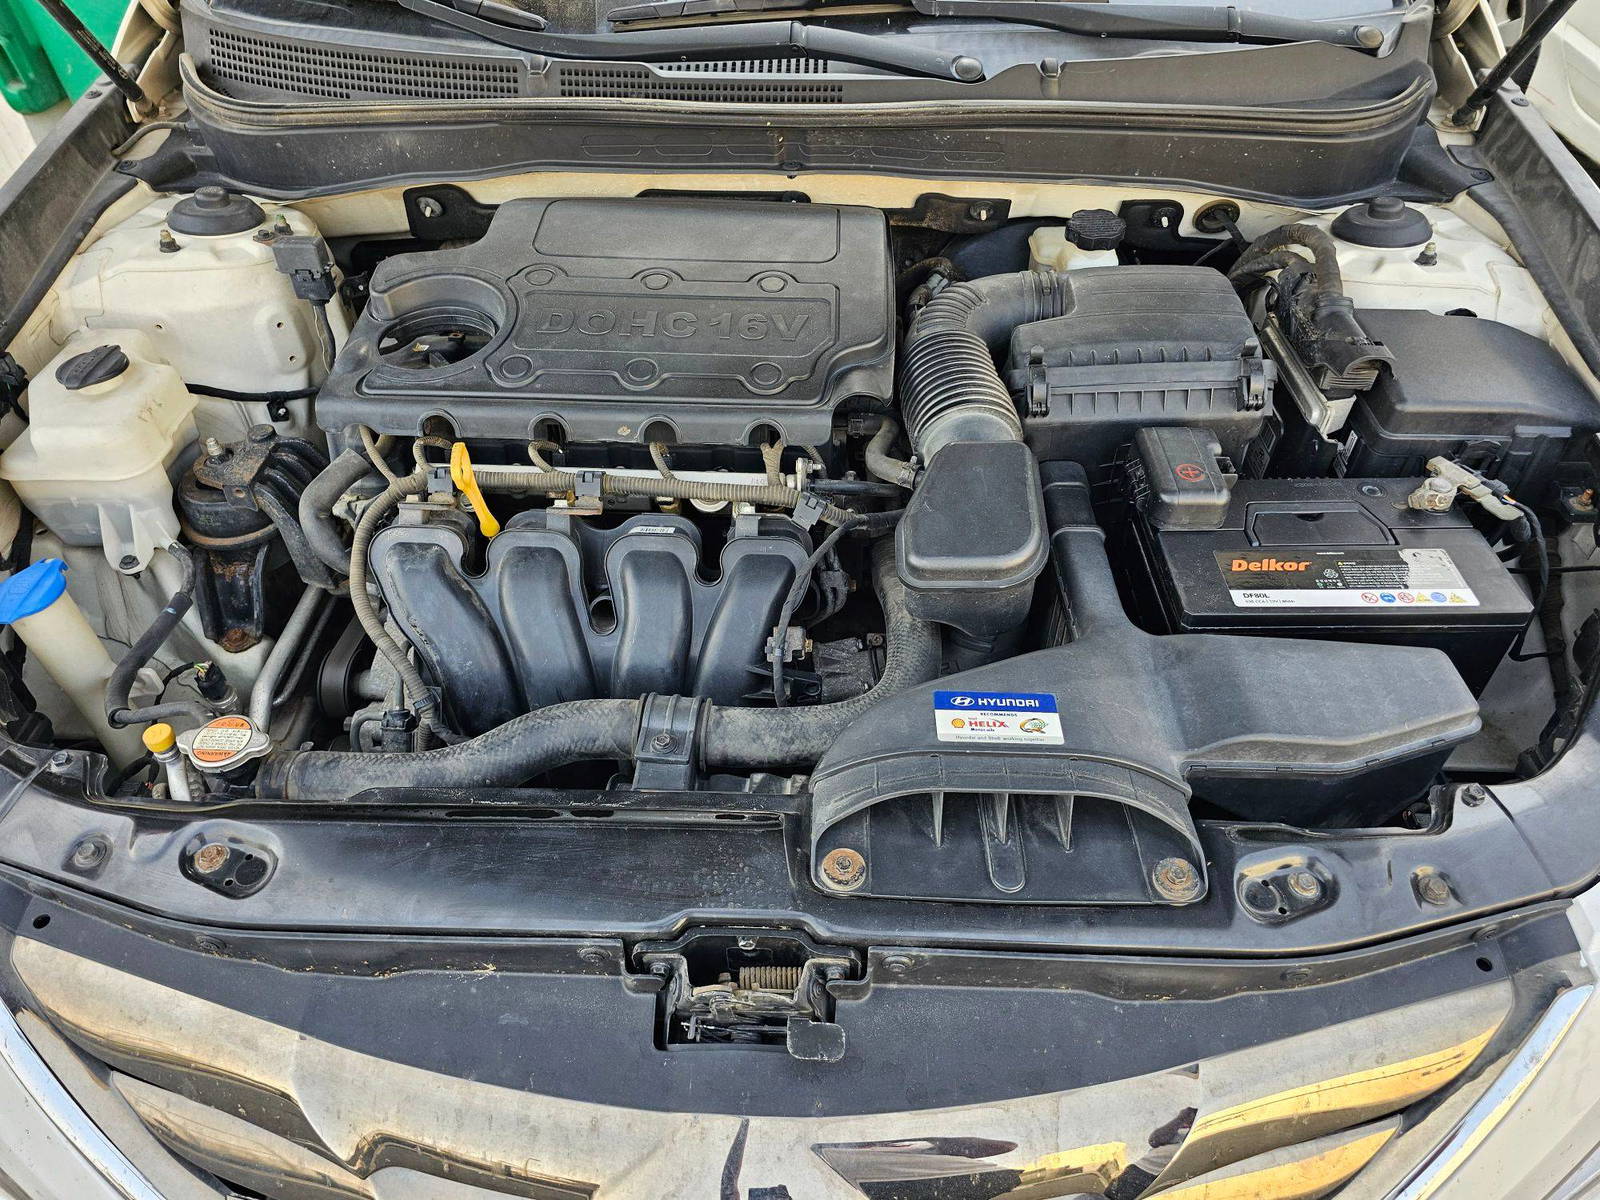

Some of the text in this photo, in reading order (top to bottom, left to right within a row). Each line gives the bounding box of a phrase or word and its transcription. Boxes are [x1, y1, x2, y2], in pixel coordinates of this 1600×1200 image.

[536, 307, 809, 341] DOHC 16V
[1231, 559, 1310, 572] Delkor
[978, 698, 1039, 707] HYUNDAI
[968, 720, 1008, 728] HELIX
